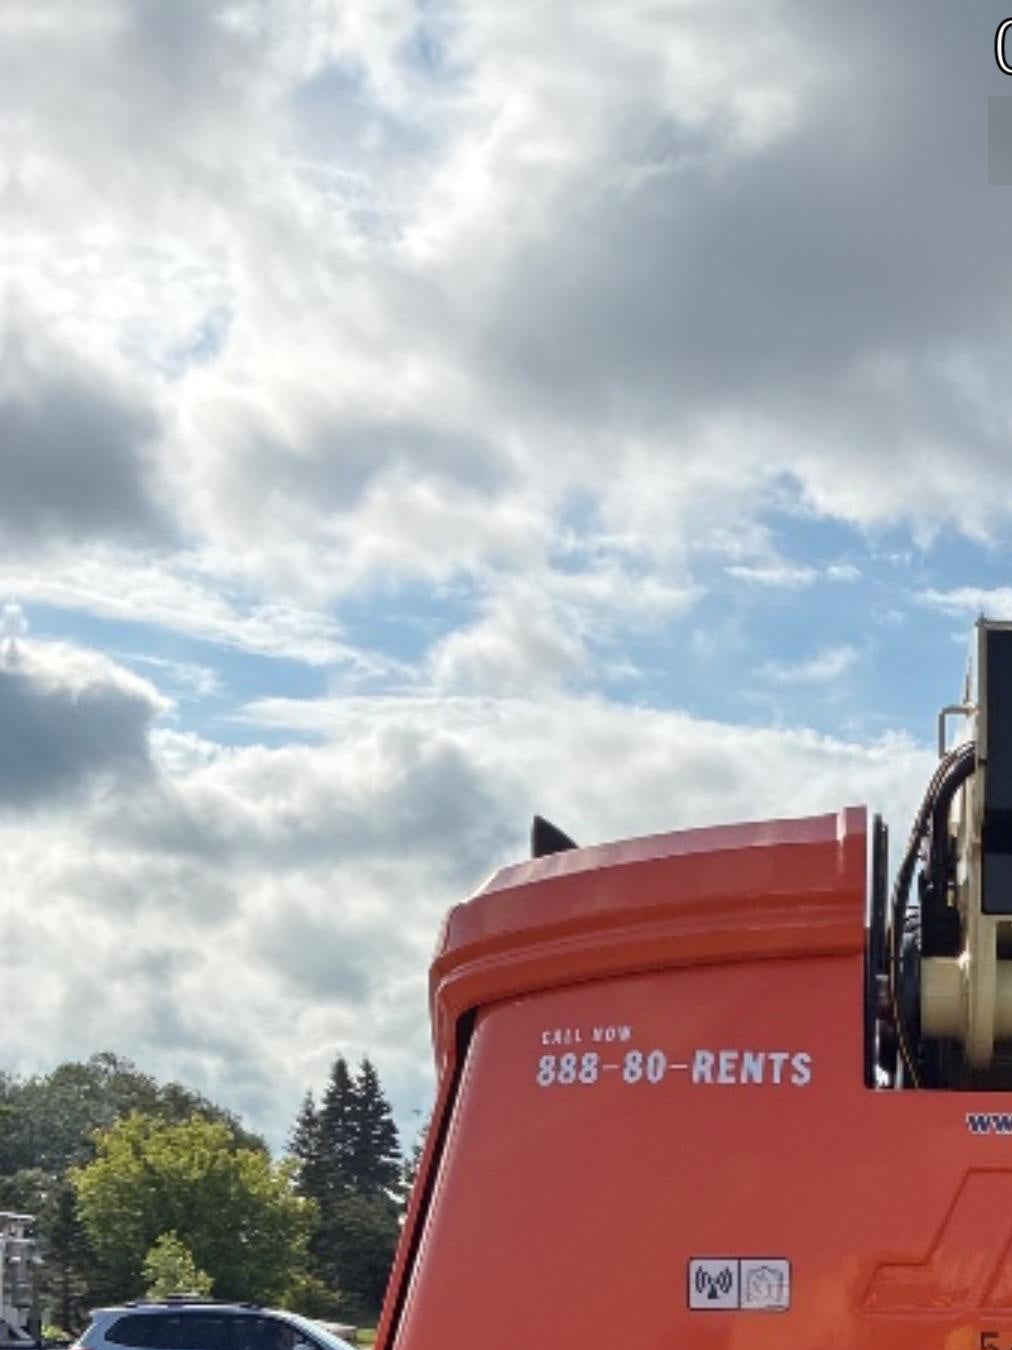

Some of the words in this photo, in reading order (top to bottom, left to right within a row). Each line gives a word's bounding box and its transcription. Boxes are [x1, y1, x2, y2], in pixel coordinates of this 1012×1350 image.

[541, 1027, 583, 1045] CALL
[592, 1026, 632, 1042] NOW
[537, 1050, 812, 1086] 888-80-RENTS
